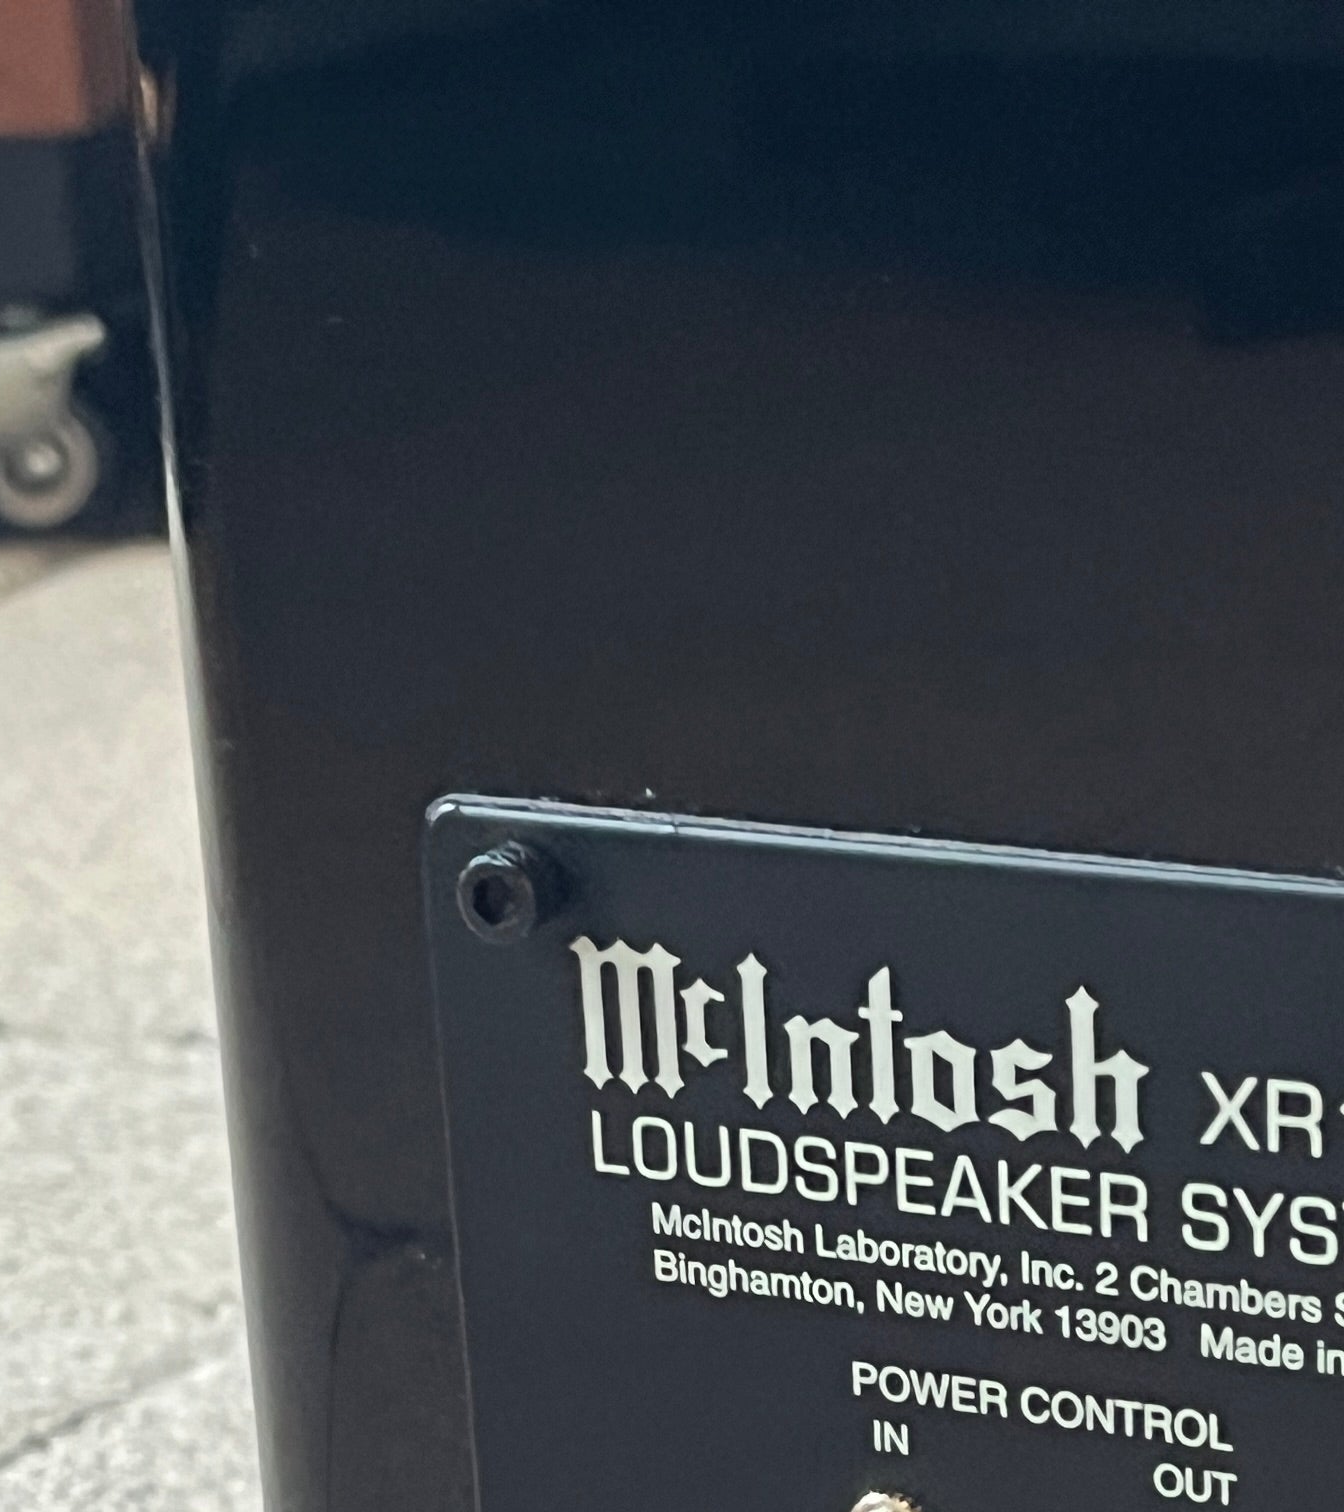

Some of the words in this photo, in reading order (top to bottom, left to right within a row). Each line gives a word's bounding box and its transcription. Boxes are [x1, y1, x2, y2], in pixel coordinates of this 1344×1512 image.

[569, 935, 1150, 1154] McIntosh
[591, 1109, 1149, 1243] LOUDSPEAKER
[651, 1202, 805, 1254] McIntosh
[814, 1223, 1008, 1288] Laboratory,
[1020, 1250, 1084, 1292] Inc.
[1094, 1261, 1120, 1297] 2
[1129, 1264, 1323, 1324] Chambers
[653, 1248, 865, 1315] Binghamton,
[876, 1279, 955, 1321] New
[963, 1290, 1044, 1335] York
[1054, 1305, 1167, 1352] 13903
[1200, 1322, 1305, 1371] Made
[851, 1360, 1008, 1419] POWER
[1020, 1386, 1234, 1452] CONTROL
[872, 1419, 909, 1456] IN
[1152, 1462, 1238, 1506] OUT
